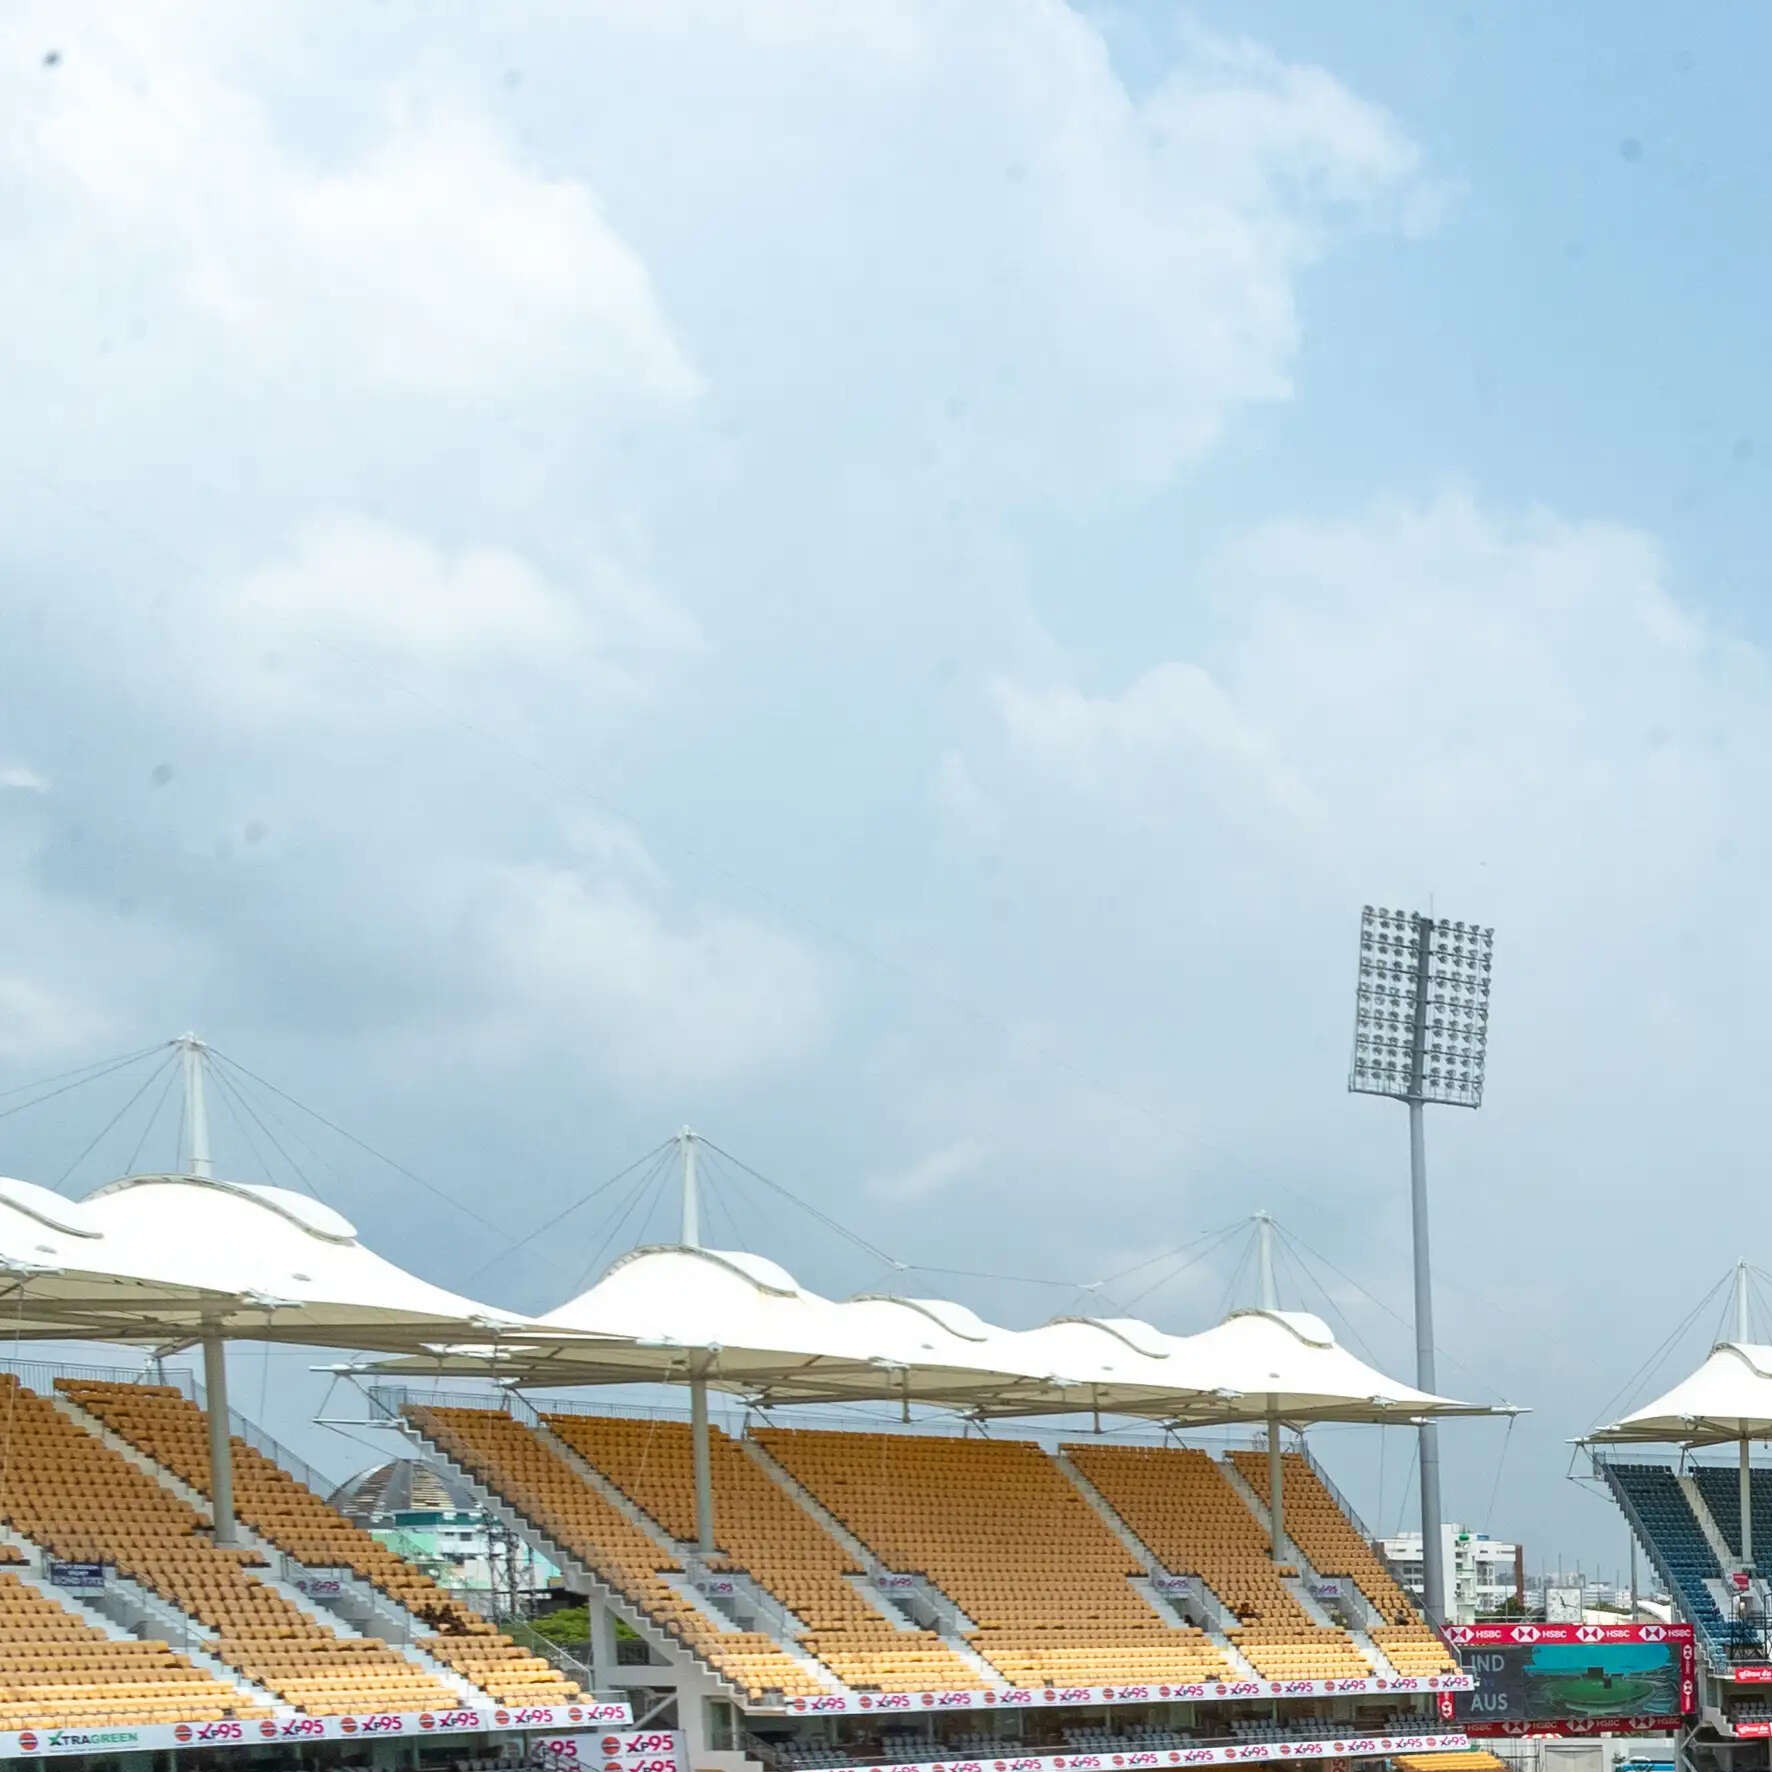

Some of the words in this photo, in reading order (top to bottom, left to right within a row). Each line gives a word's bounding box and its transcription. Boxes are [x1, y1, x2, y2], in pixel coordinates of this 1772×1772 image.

[1475, 1629, 1502, 1640] HSBC
[1541, 1629, 1567, 1639] HSBC
[1605, 1629, 1631, 1639] HSBC
[1667, 1628, 1692, 1638] HSBC
[1470, 1655, 1505, 1672] IND
[1470, 1693, 1509, 1712] AUS
[48, 1730, 138, 1747] XTRAGREEN
